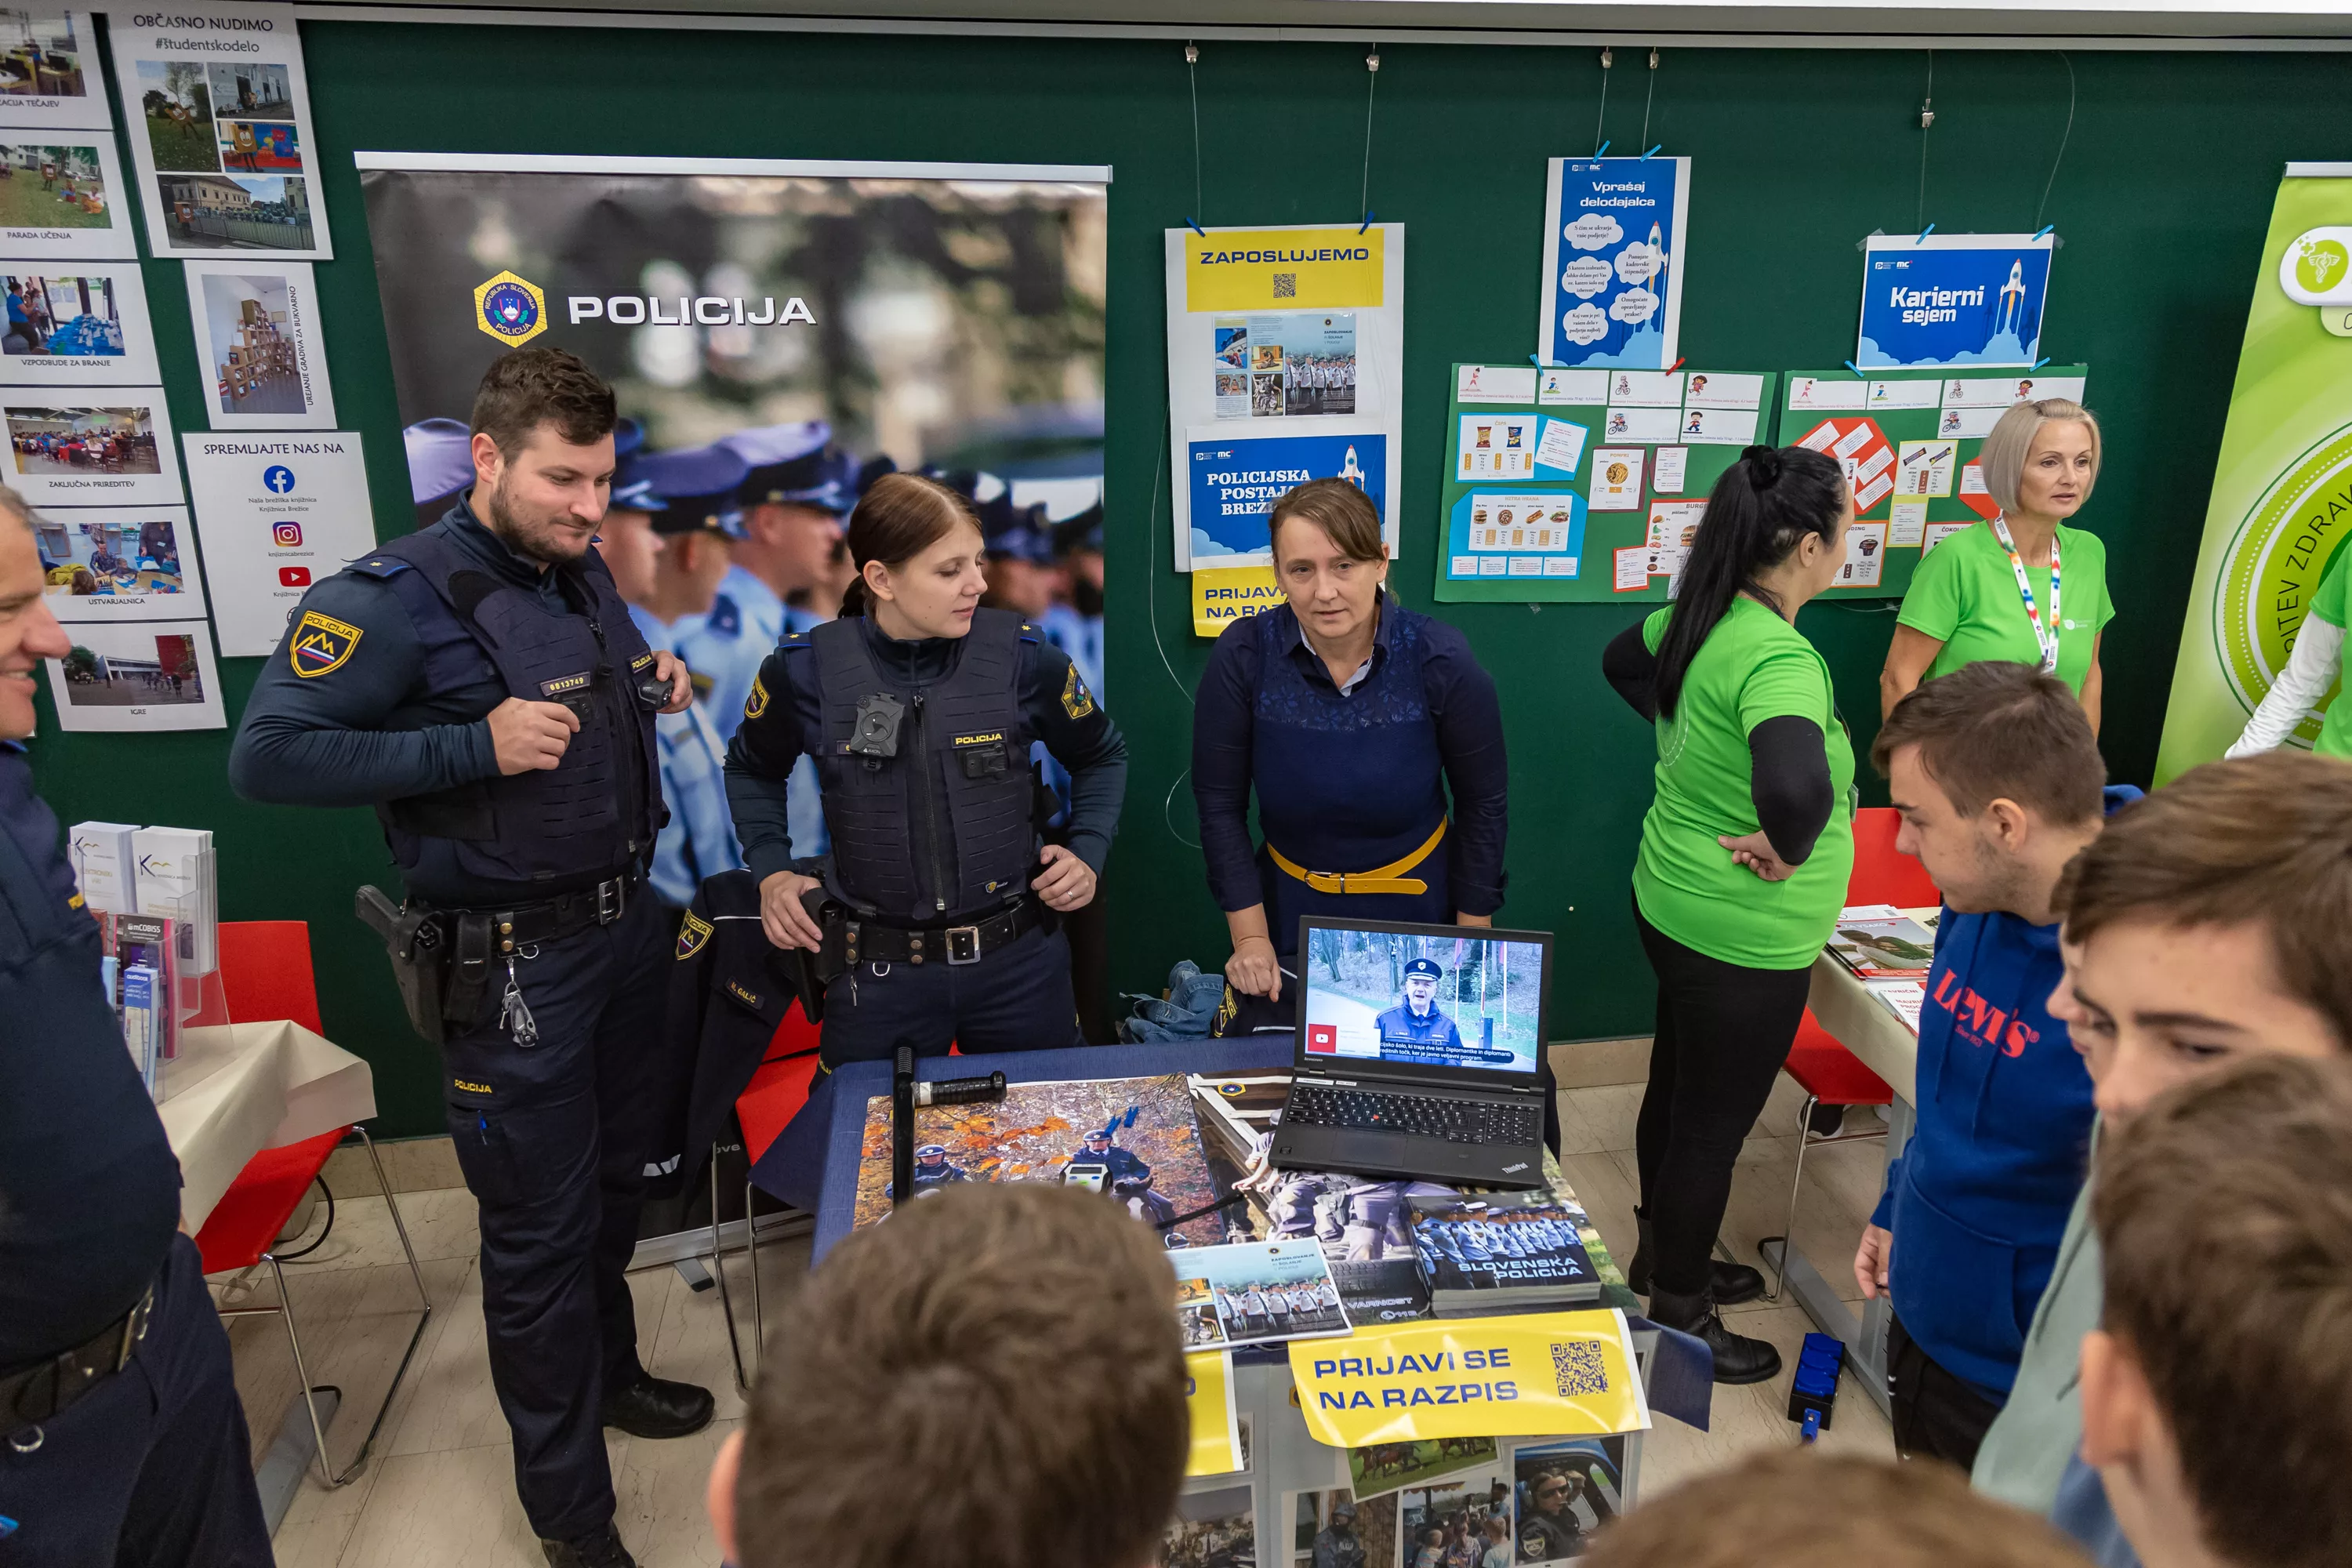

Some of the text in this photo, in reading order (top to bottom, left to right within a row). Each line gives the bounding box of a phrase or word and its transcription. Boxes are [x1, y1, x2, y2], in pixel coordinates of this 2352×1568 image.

[134, 14, 273, 31] OBČASNO NUDIMO
[155, 38, 260, 53] #študentskodelo
[27, 98, 60, 108] TEČAJEV
[1592, 181, 1646, 193] Vprašaj
[1580, 197, 1655, 208] delodajalca
[40, 230, 72, 240] UČENJA
[1200, 249, 1368, 264] ZAPOSLUJEMO
[485, 285, 535, 310] REPUBLIKA SLOVENIJA
[1890, 285, 1985, 307] Karierni
[568, 296, 818, 325] POLICIJA
[1902, 306, 1957, 326] sejem
[495, 323, 532, 335] POLICIJA
[289, 286, 314, 405] UREJANJE GRADIVA ZA BUKVARNO
[21, 358, 67, 367] VZPODBUDE
[82, 358, 111, 367] BRANJE
[204, 443, 344, 454] SPREMLJAJTE NAS NA
[49, 480, 136, 488] ZAKLJUČNA PRIREDITEV
[1207, 470, 1311, 486] POLICIJSKA
[1205, 586, 1287, 601] PRIJAV
[1207, 607, 1238, 618] NA
[307, 616, 353, 638] POLICIJA
[955, 732, 1003, 745] POLICIJA
[731, 982, 736, 991] M.
[455, 1079, 492, 1093] POLICIJA
[1501, 1161, 1529, 1174] ThinkPad
[1458, 1257, 1579, 1272] SLOVENSKA
[1497, 1265, 1584, 1279] POLICIJA
[1348, 1297, 1413, 1309] VARNOST
[1314, 1348, 1512, 1379] PRIJAVI SE
[1318, 1381, 1519, 1410] NA RAZPIS
